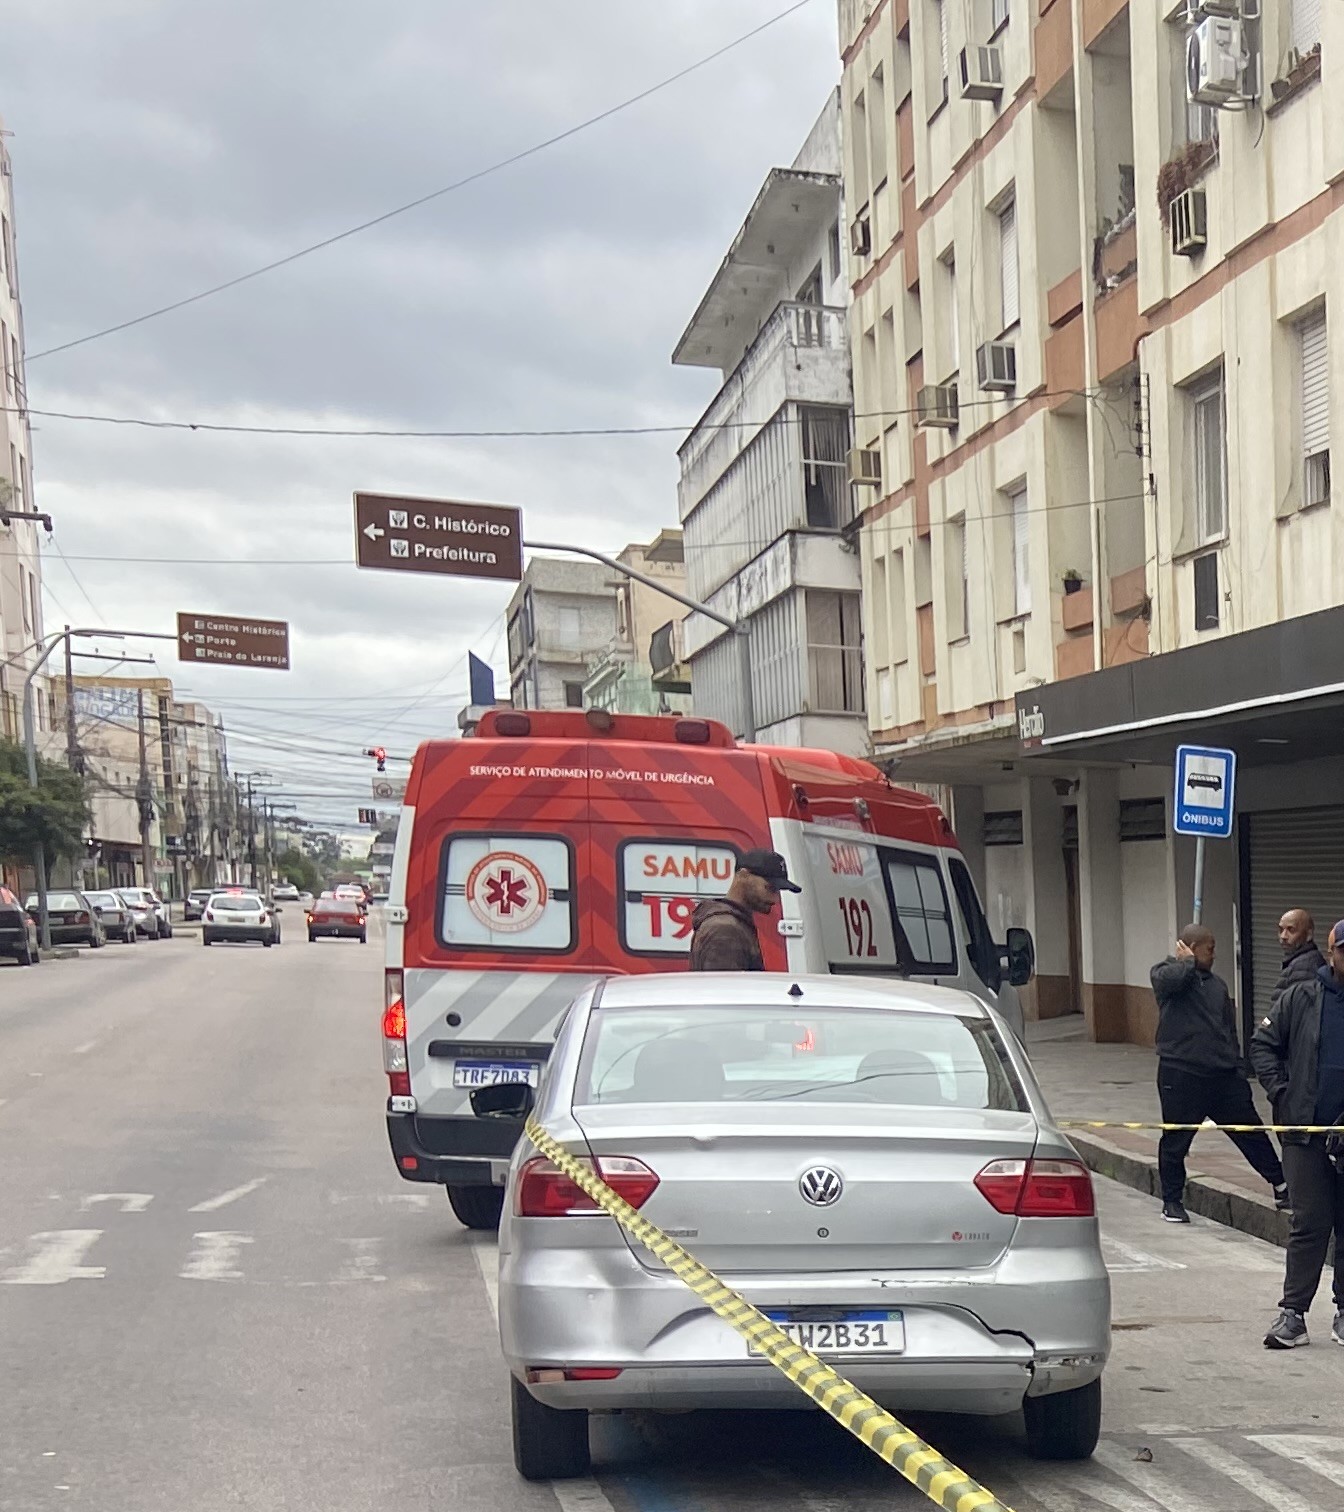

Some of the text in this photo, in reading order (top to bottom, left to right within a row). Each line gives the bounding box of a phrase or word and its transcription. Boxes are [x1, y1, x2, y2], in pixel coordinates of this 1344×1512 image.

[413, 514, 511, 536] C. Histórico
[414, 543, 497, 564] Prefeitura
[470, 765, 512, 778] SERVIÇO
[513, 766, 526, 777] DE
[528, 767, 602, 779] ATENDIMENTO
[606, 769, 643, 782] MÓVEL
[645, 772, 658, 782] DE
[1182, 812, 1224, 827] ÔNIBUS
[643, 854, 731, 880] SAMU
[827, 841, 863, 877] SAMU
[643, 896, 697, 939] 19
[839, 896, 878, 958] 192
[780, 1323, 888, 1348] TW2B31
